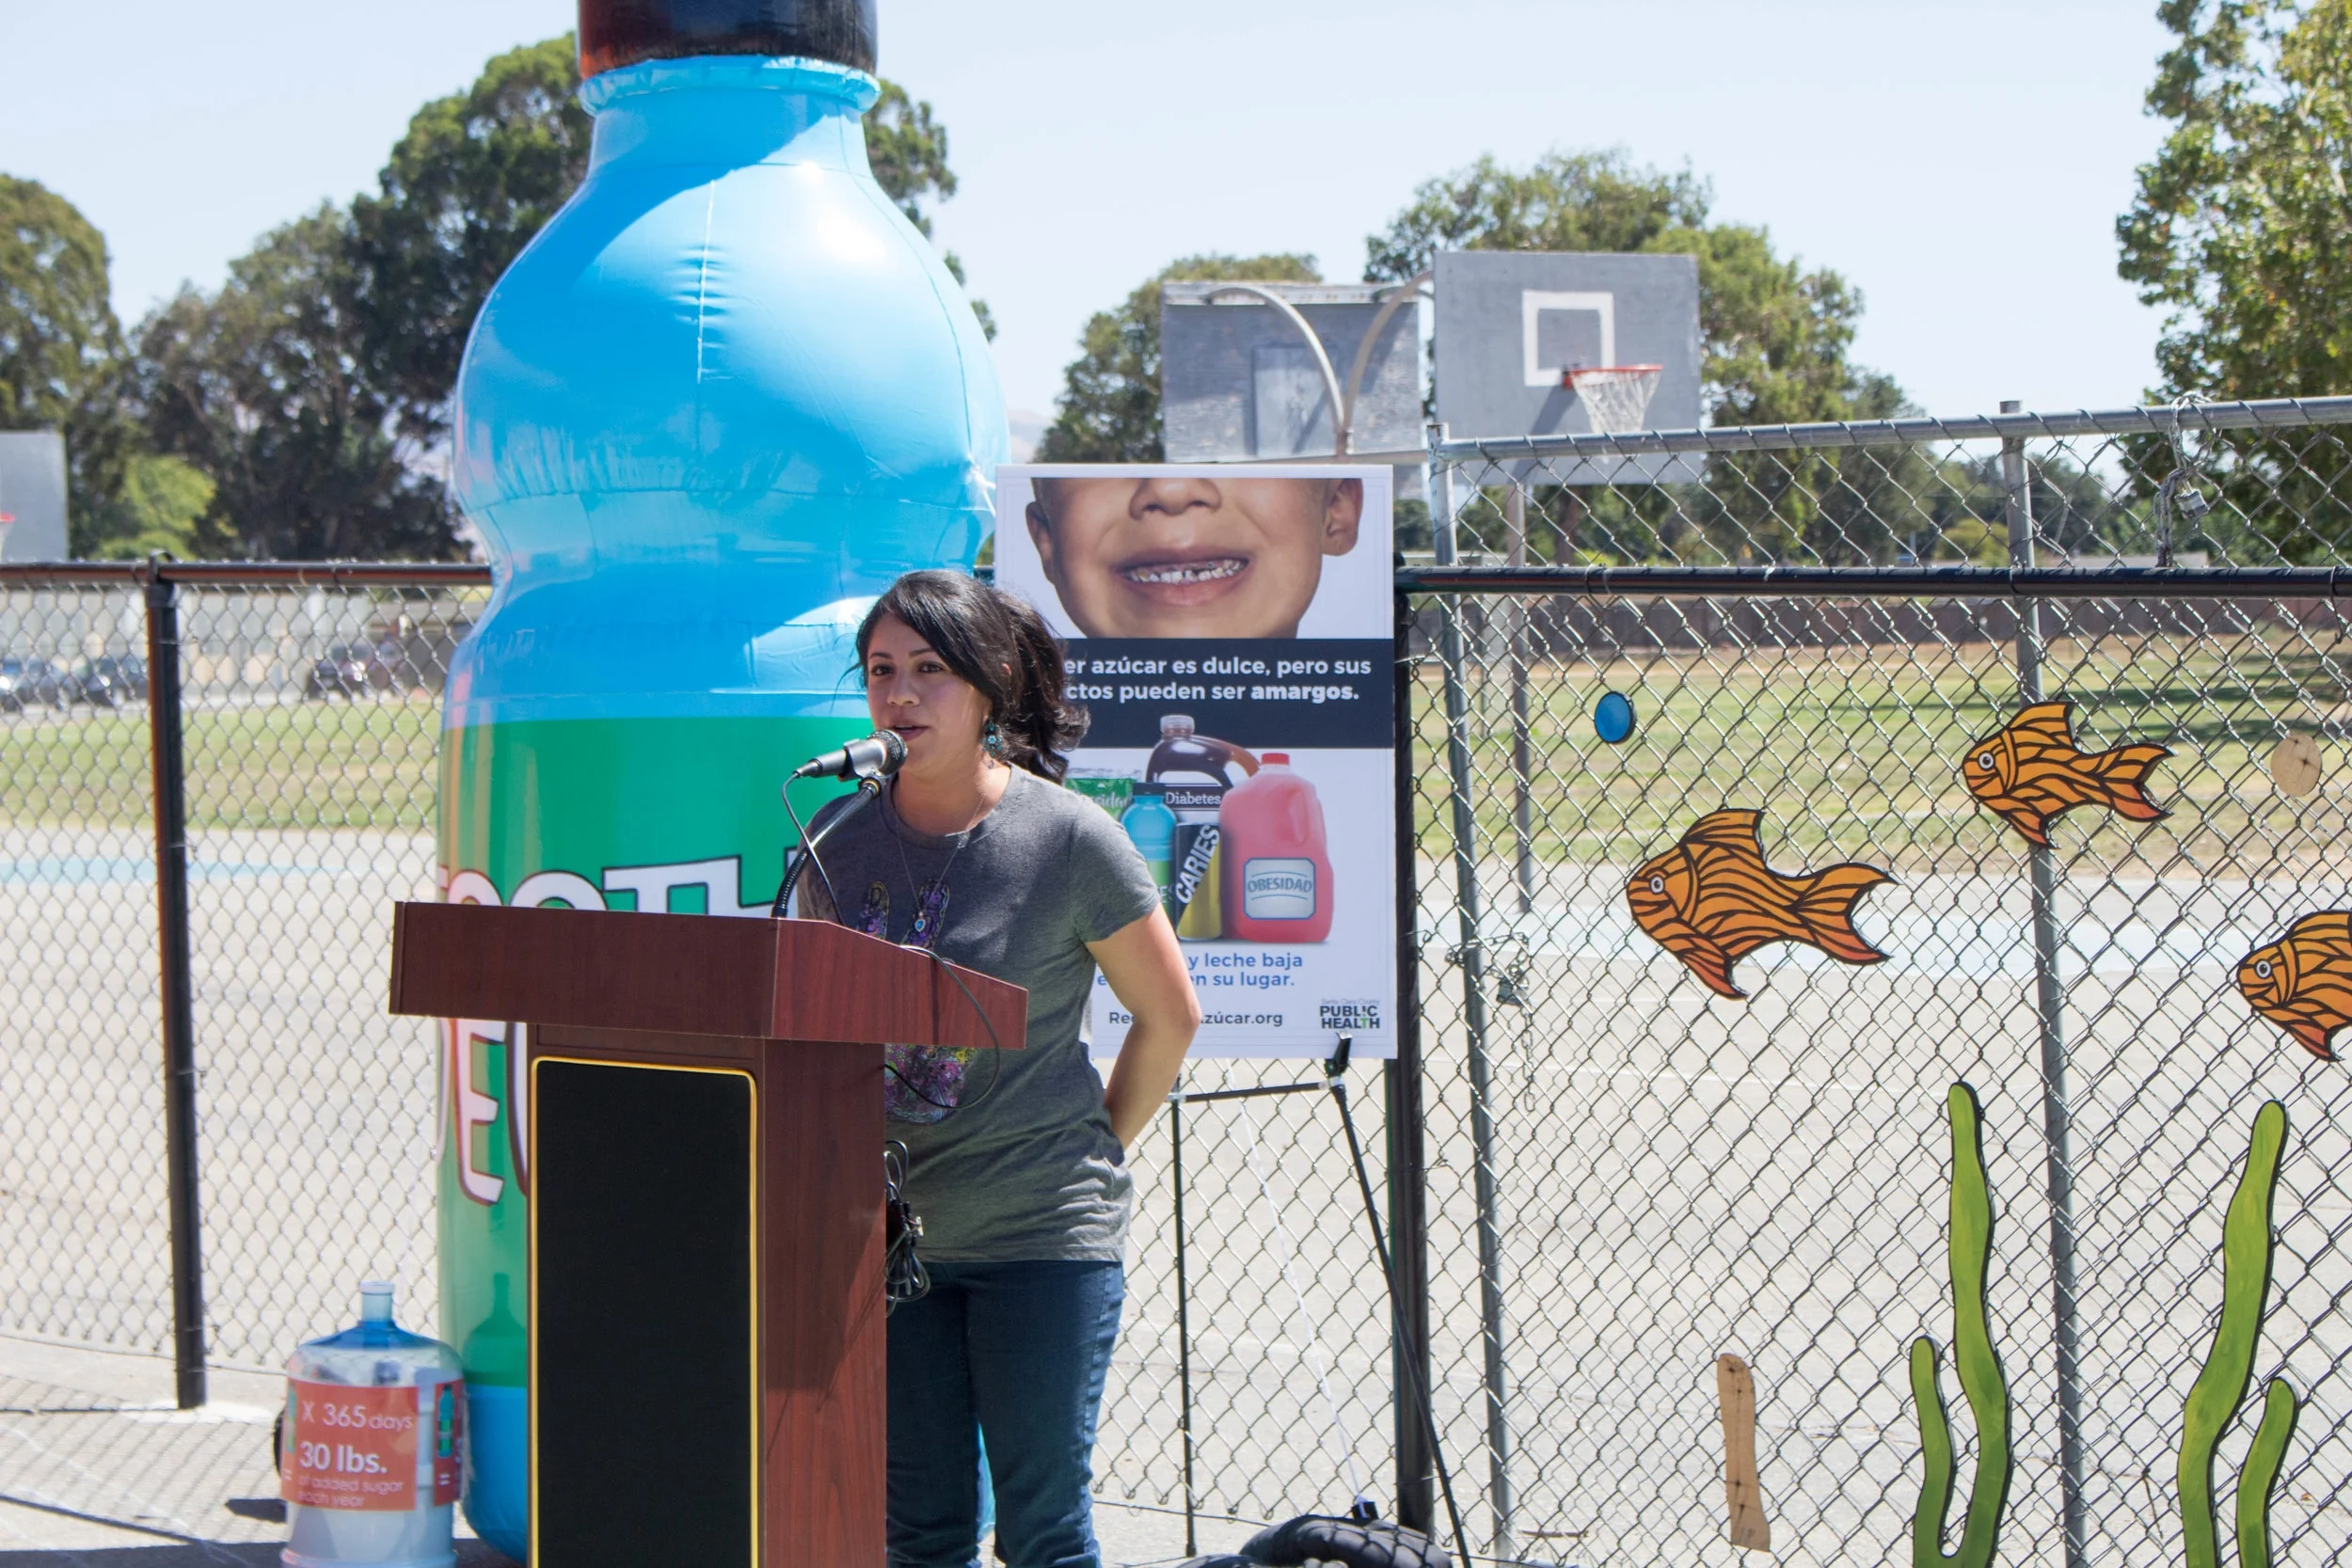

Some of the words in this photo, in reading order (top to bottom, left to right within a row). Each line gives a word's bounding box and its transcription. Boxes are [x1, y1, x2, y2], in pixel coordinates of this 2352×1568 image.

[1091, 656, 1167, 674] azúcar
[1172, 660, 1197, 674] es
[1202, 657, 1270, 676] dulce,
[1277, 660, 1328, 678] pero
[1334, 660, 1372, 674] sus
[1120, 682, 1206, 704] pueden
[1211, 686, 1246, 700] ser
[1251, 685, 1359, 704] amargos.
[1166, 792, 1221, 805] Diabetes
[1176, 825, 1221, 904] CARIES
[1248, 878, 1313, 894] OBESIDAD
[1188, 956, 1199, 970] y
[1204, 953, 1256, 967] leche
[1263, 952, 1303, 971] baja
[1213, 975, 1233, 986] su
[1240, 973, 1295, 990] lugar.
[1322, 1017, 1380, 1029] HEALTH
[322, 1402, 367, 1428] 365
[368, 1413, 413, 1432] days
[298, 1441, 331, 1470] 30
[336, 1444, 389, 1474] lbs.
[310, 1477, 359, 1491] added
[361, 1481, 404, 1496] sugar
[298, 1491, 328, 1504] each
[331, 1496, 365, 1507] year
